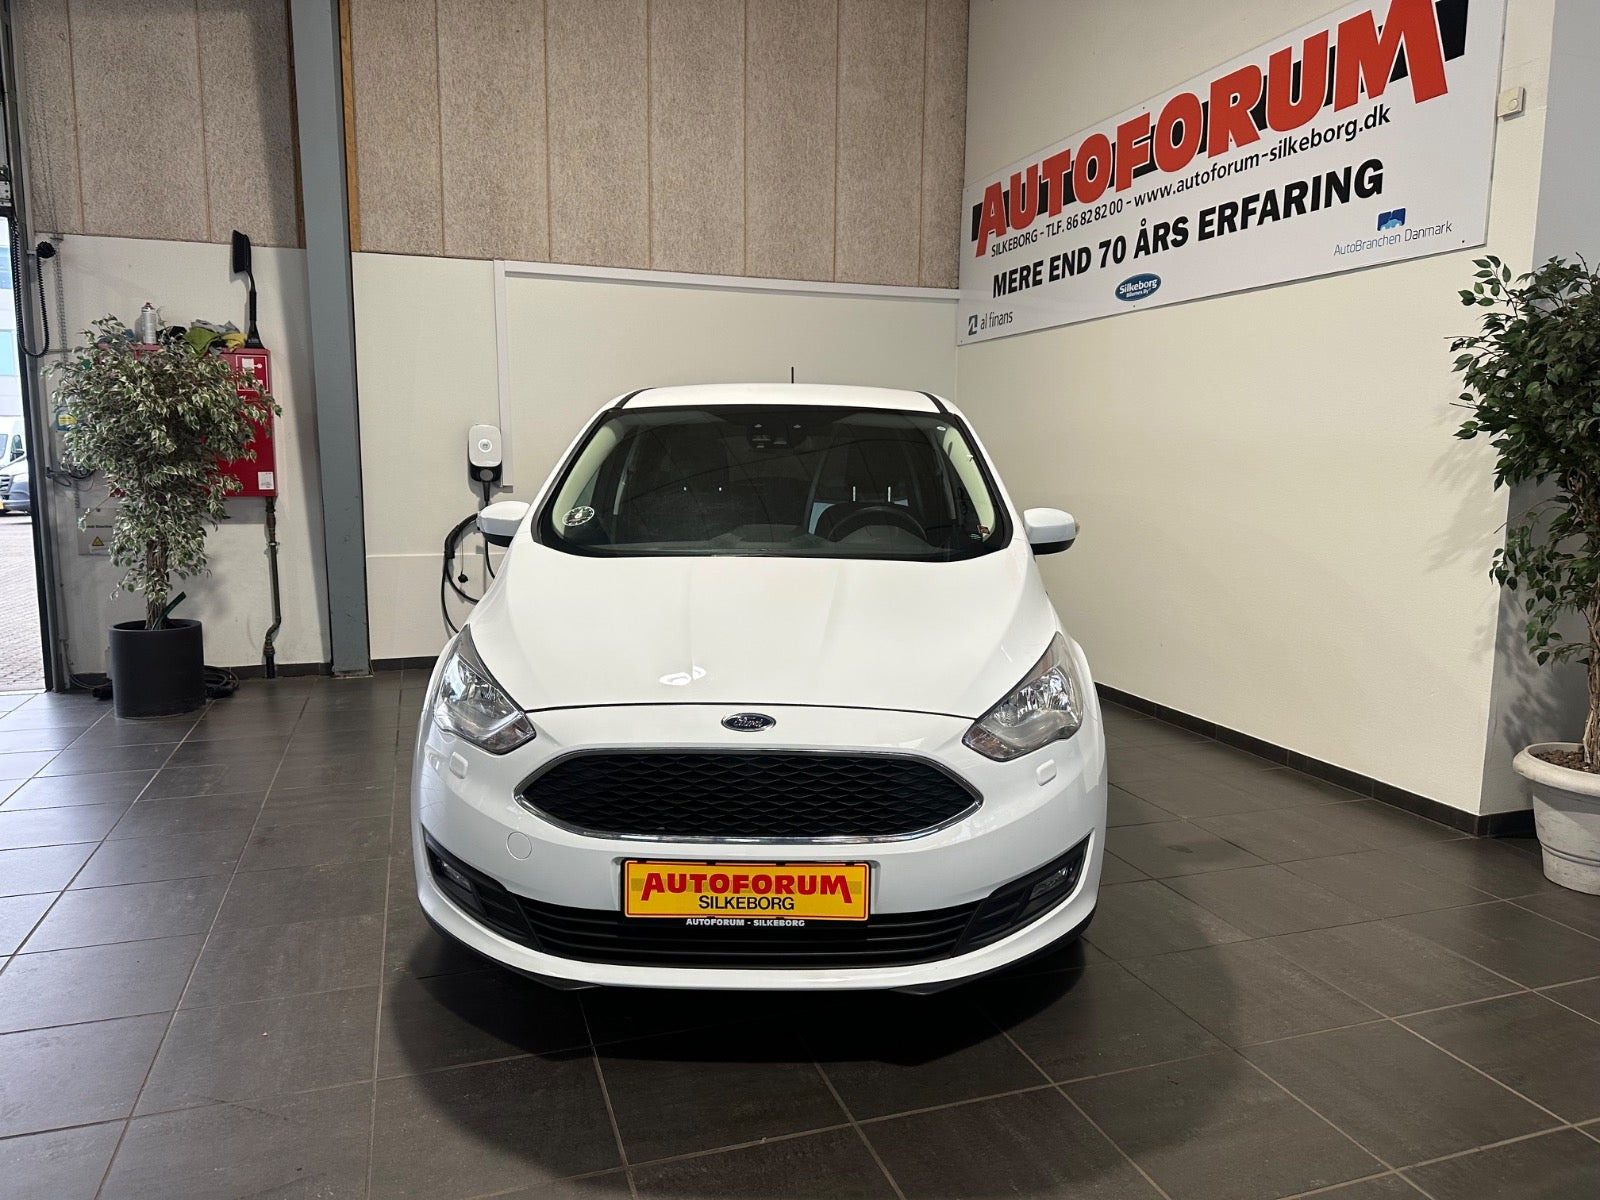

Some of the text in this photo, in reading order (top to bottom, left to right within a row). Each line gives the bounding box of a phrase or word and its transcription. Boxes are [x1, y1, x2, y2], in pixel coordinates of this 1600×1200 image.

[975, 0, 1448, 257] AUTOFORUM
[991, 229, 1038, 257] SILKEBORG
[1046, 220, 1065, 237] TLF.
[1134, 103, 1391, 207] www.autoforum-silkeborg.dk
[993, 158, 1384, 298] MERE END 70 ÅRS ERFARING
[1333, 220, 1453, 256] AutoBranchen Danmark
[1119, 279, 1158, 294] Silkeborg
[980, 311, 1013, 330] al finans
[641, 873, 852, 904] AUTOFORUM
[698, 895, 795, 910] SILKEBORG
[686, 918, 745, 927] AUTOFORUM
[753, 919, 805, 927] SILKEBORG
